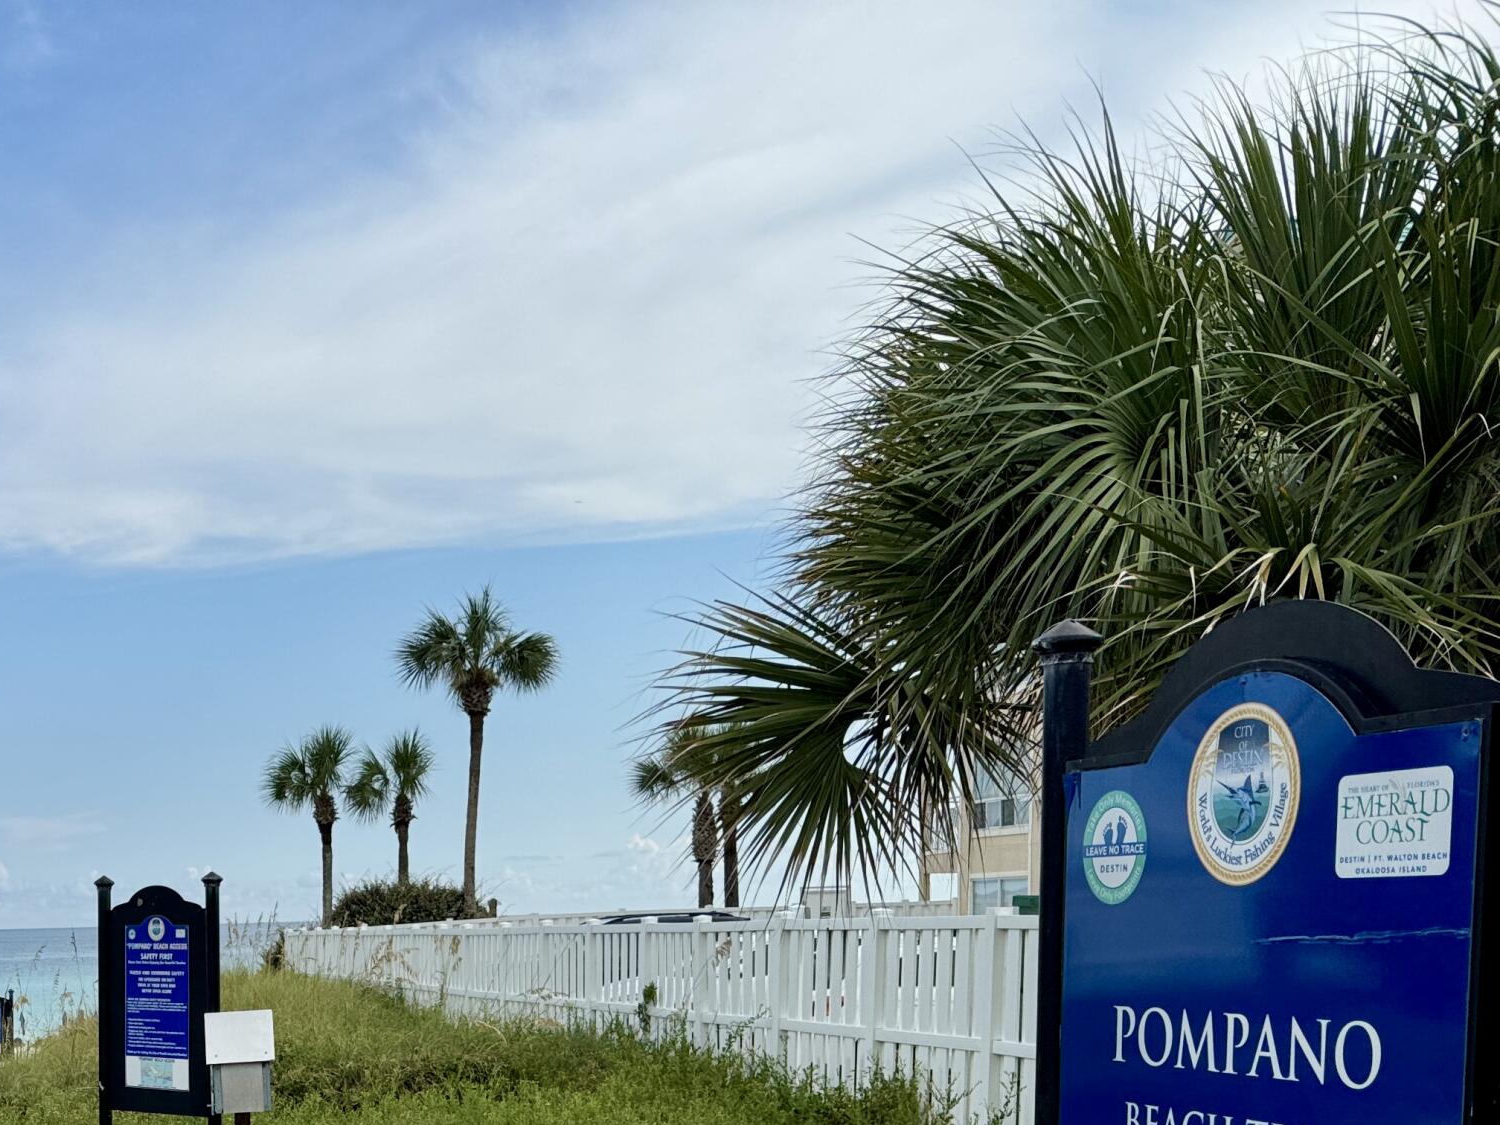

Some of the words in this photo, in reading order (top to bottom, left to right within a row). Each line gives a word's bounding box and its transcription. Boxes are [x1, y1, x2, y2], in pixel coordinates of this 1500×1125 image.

[1234, 724, 1256, 739] CITY
[1238, 740, 1249, 751] OF
[1223, 750, 1264, 769] DESTIN
[1360, 784, 1380, 793] HEART
[1381, 783, 1389, 792] OF
[1340, 787, 1451, 820] EMERALD
[1197, 791, 1213, 842] World's
[1209, 837, 1243, 866] Luckiest
[1243, 830, 1276, 865] Fishing
[1269, 782, 1290, 828] Village
[1355, 816, 1431, 845] COAST
[1085, 845, 1108, 857] LEAVE
[1108, 844, 1120, 856] NO
[1121, 843, 1145, 855] TRACE
[1339, 855, 1365, 864] DESTIN
[1373, 854, 1385, 863] FT.
[1386, 852, 1419, 863] WALTON
[1421, 851, 1448, 861] BEACH
[1100, 863, 1128, 874] DESTIN
[1355, 866, 1396, 875] OKALOOSA
[1398, 864, 1428, 874] ISLAND
[1112, 1004, 1382, 1090] POMPANO
